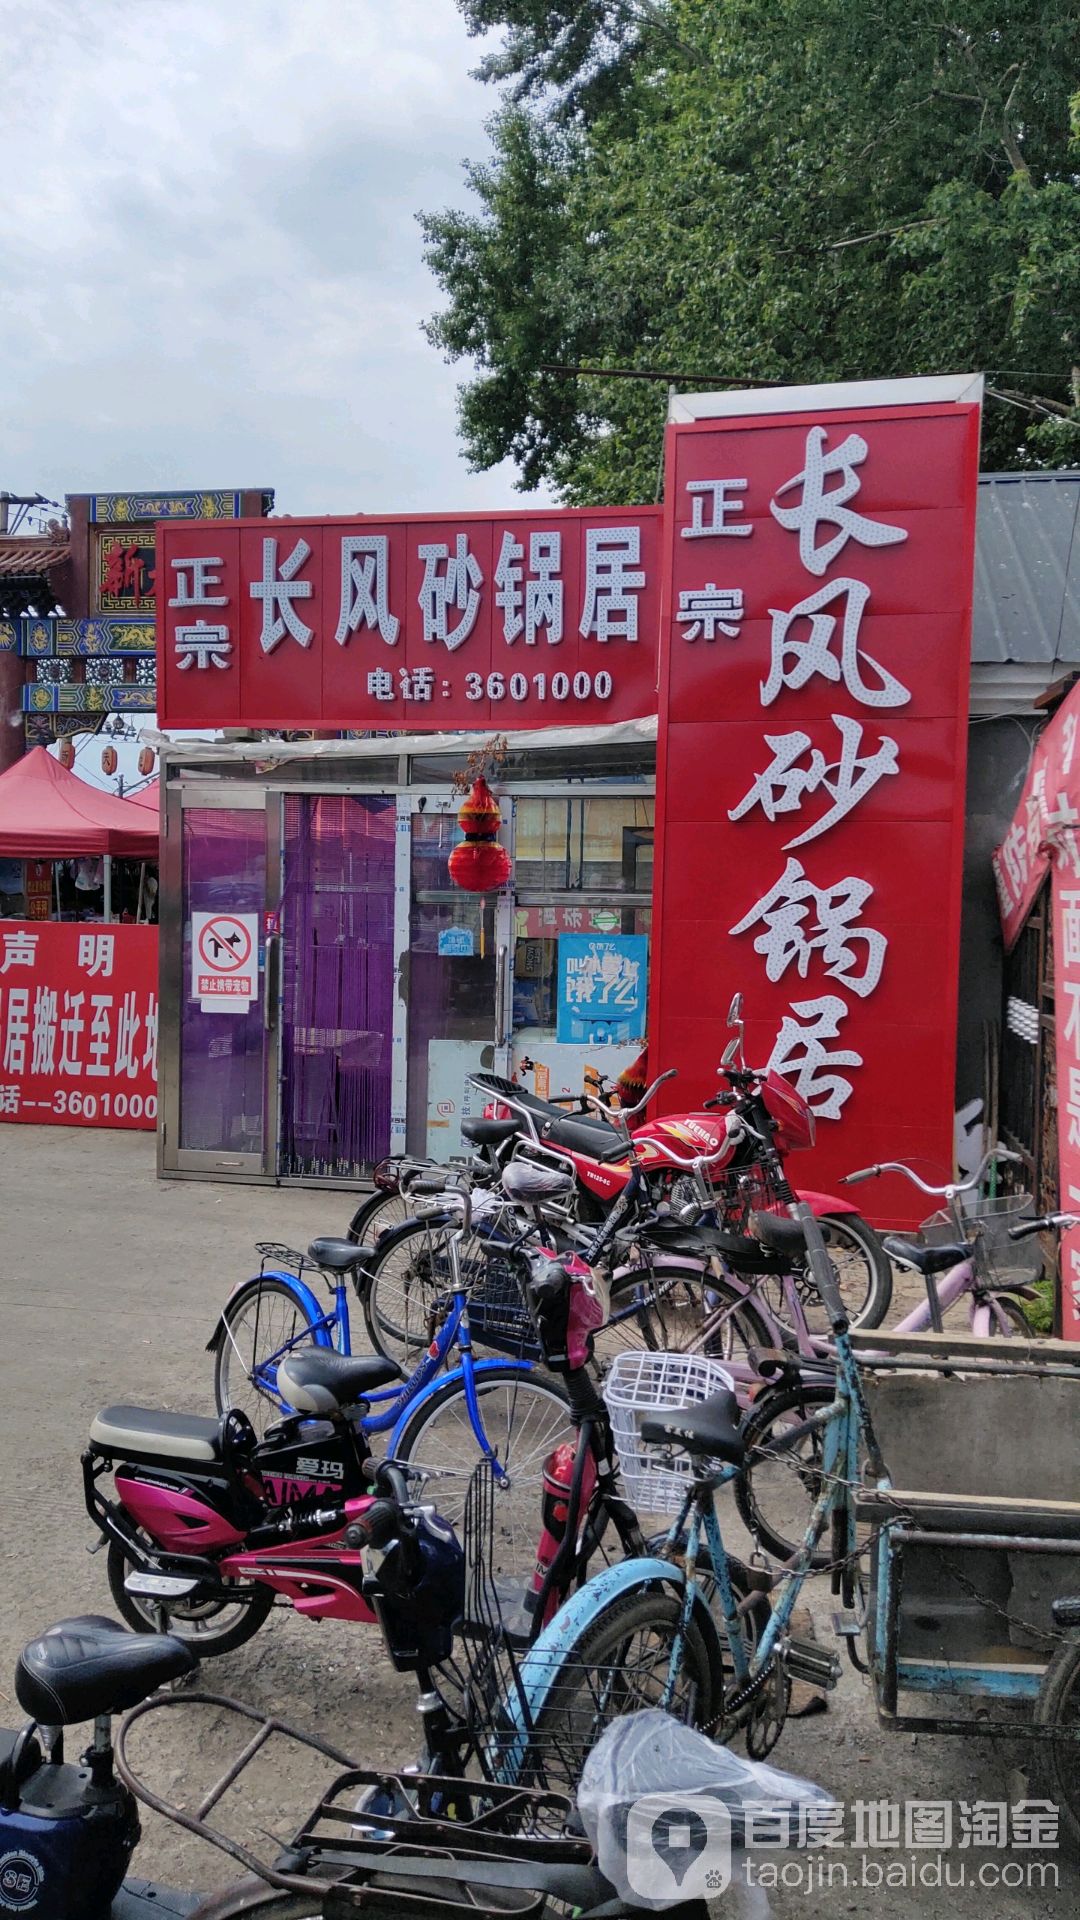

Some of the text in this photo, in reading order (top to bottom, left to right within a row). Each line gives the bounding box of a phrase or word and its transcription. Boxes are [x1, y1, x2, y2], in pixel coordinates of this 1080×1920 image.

[168, 556, 232, 669] 正宗
[249, 526, 646, 652] 长风砂锅居
[676, 478, 753, 641] 正宗
[727, 426, 909, 1121] 长风砂锅居
[0, 930, 115, 977] 声明
[0, 985, 159, 1082] 居搬迁至此地
[296, 1457, 344, 1479] 爱玛
